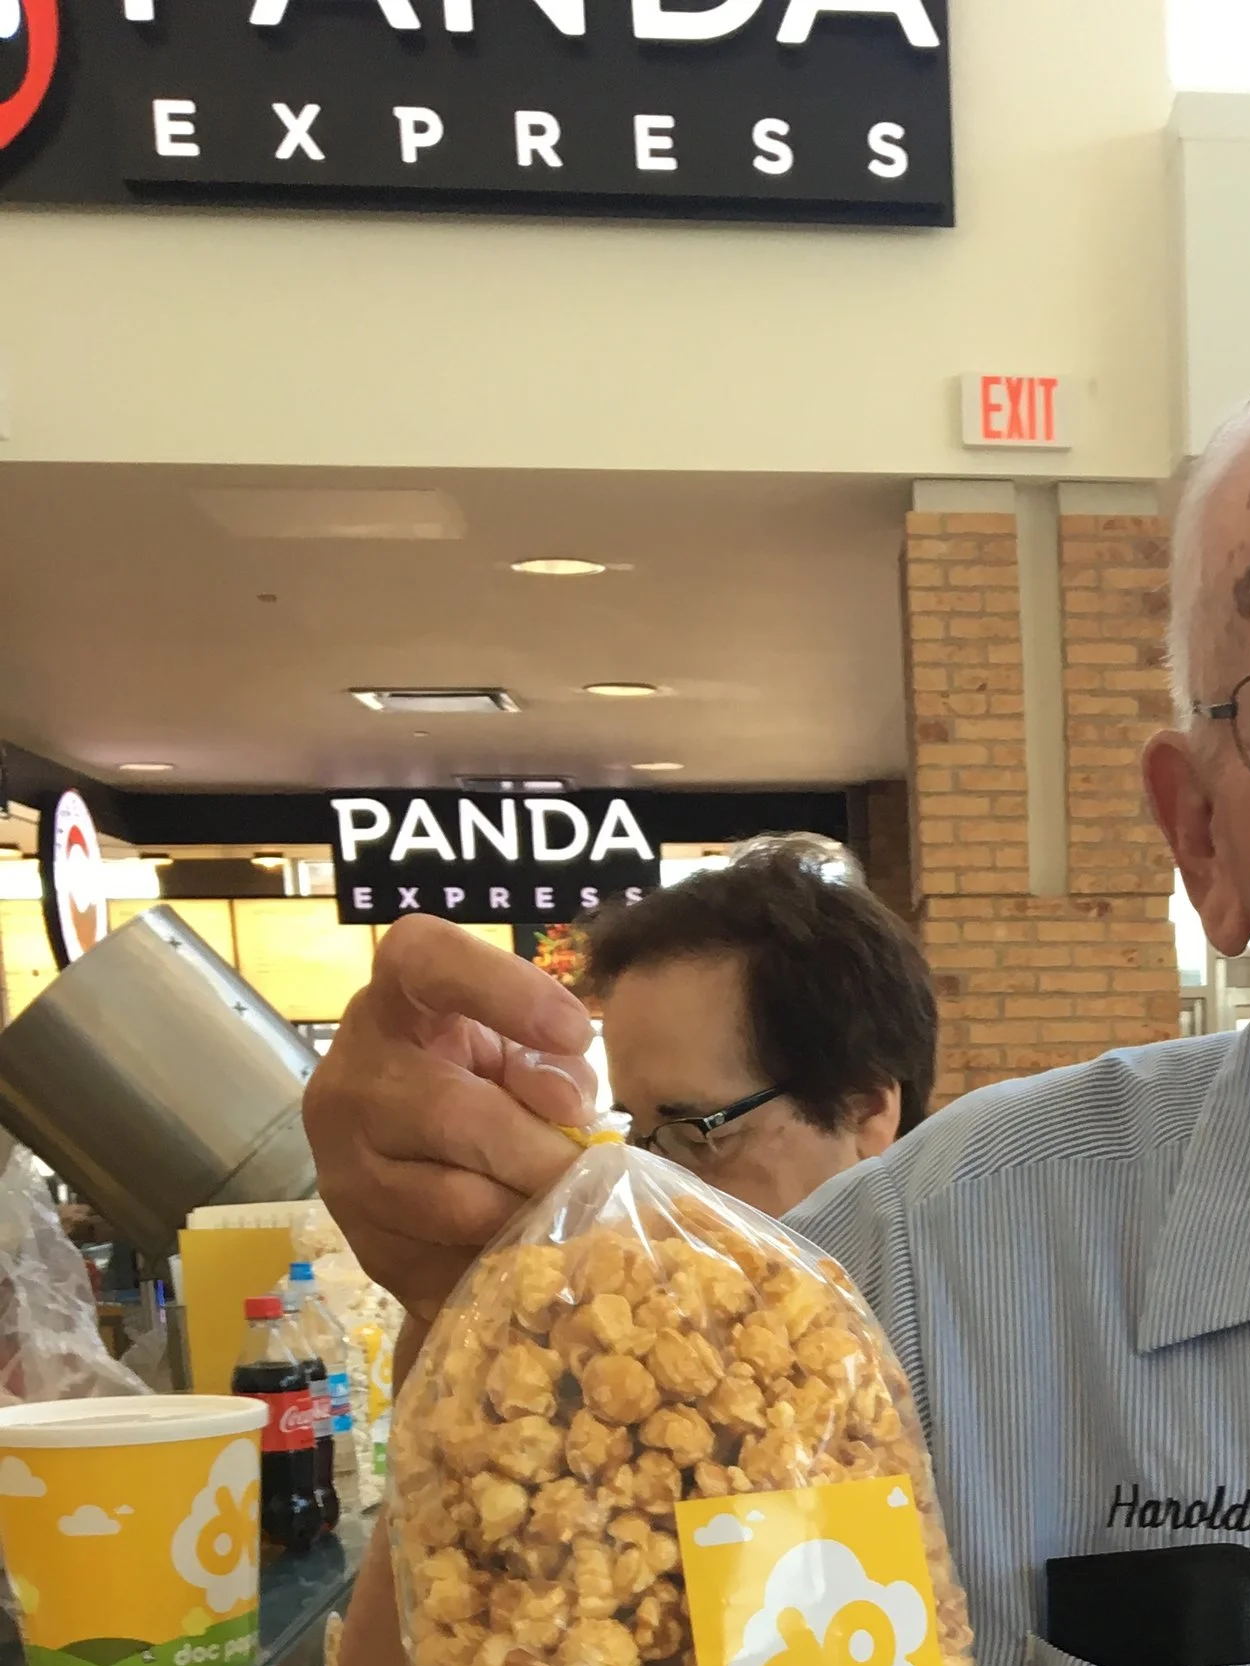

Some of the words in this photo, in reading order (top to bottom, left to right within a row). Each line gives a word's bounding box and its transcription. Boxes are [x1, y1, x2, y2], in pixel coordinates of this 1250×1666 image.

[153, 98, 910, 178] EXPRESS
[981, 376, 1058, 440] EXIT
[331, 798, 655, 861] PANDA
[353, 887, 643, 909] EXPRESS
[173, 1643, 220, 1666] doc
